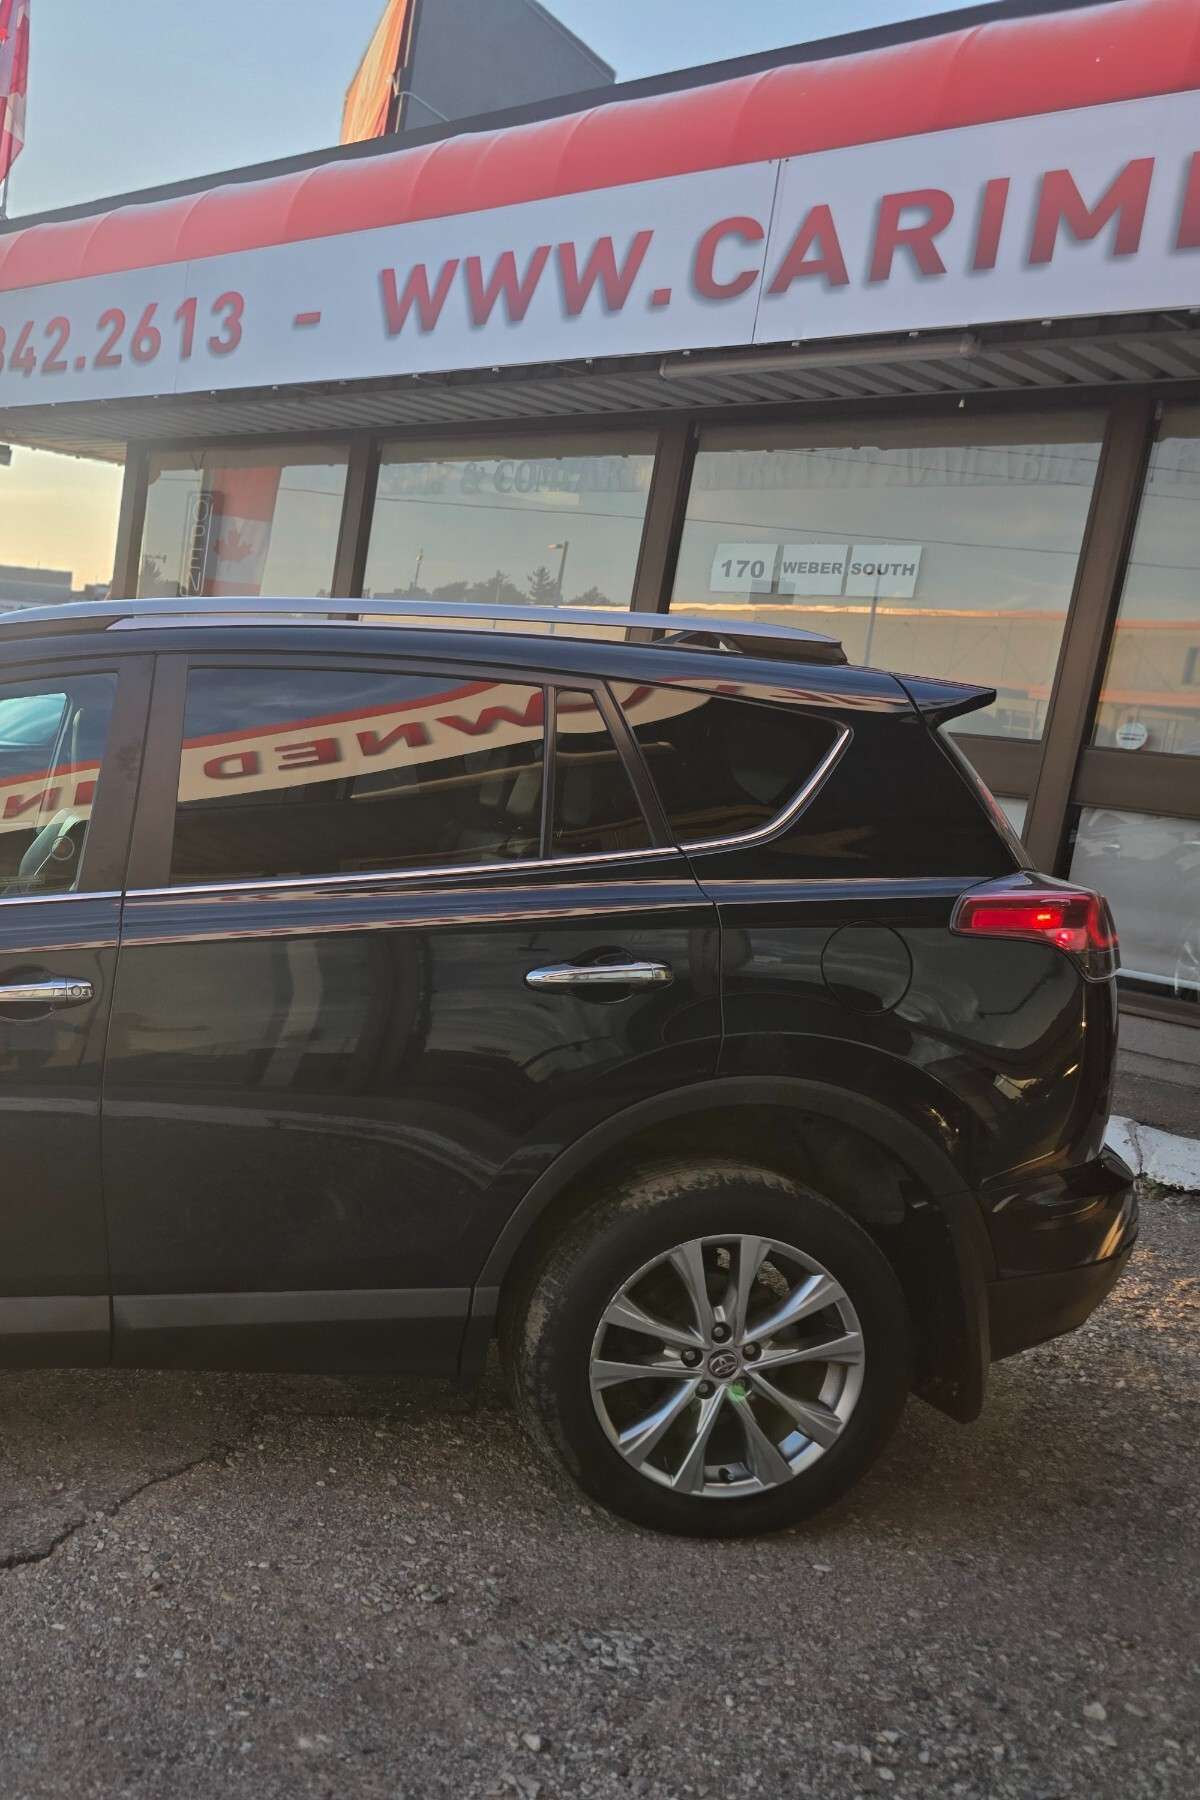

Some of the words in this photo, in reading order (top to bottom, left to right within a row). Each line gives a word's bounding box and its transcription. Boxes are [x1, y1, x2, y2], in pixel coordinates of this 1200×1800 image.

[191, 500, 210, 592] OPEN
[721, 560, 765, 579] 170
[783, 561, 843, 576] WEBER
[850, 562, 916, 577] SOUTH
